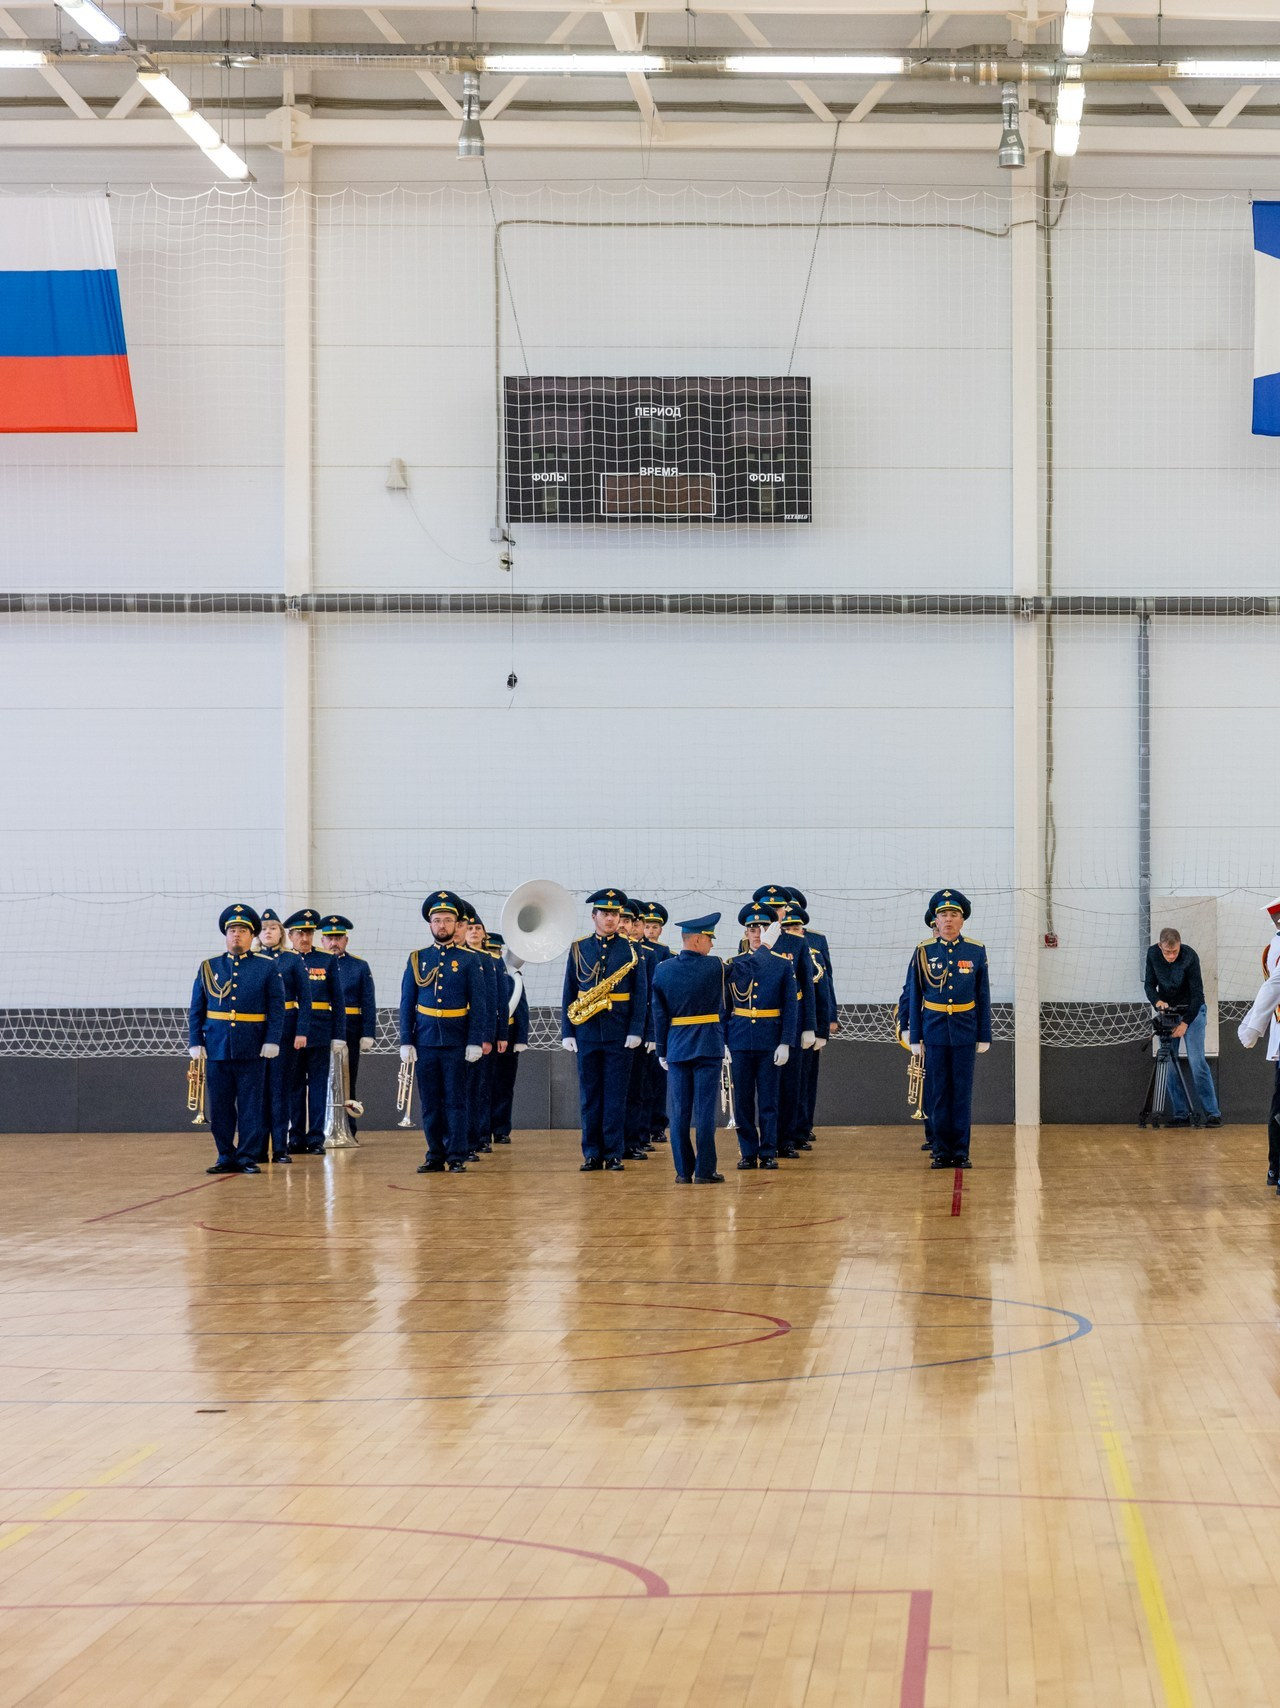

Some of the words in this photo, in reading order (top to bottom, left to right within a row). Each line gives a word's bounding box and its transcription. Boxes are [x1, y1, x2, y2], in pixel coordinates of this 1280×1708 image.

[635, 407, 682, 418] ПЕРИОД
[640, 467, 678, 477] ВРЕМЯ
[532, 473, 567, 482] ФОЛЫ
[749, 473, 785, 482] ФОЛЫ
